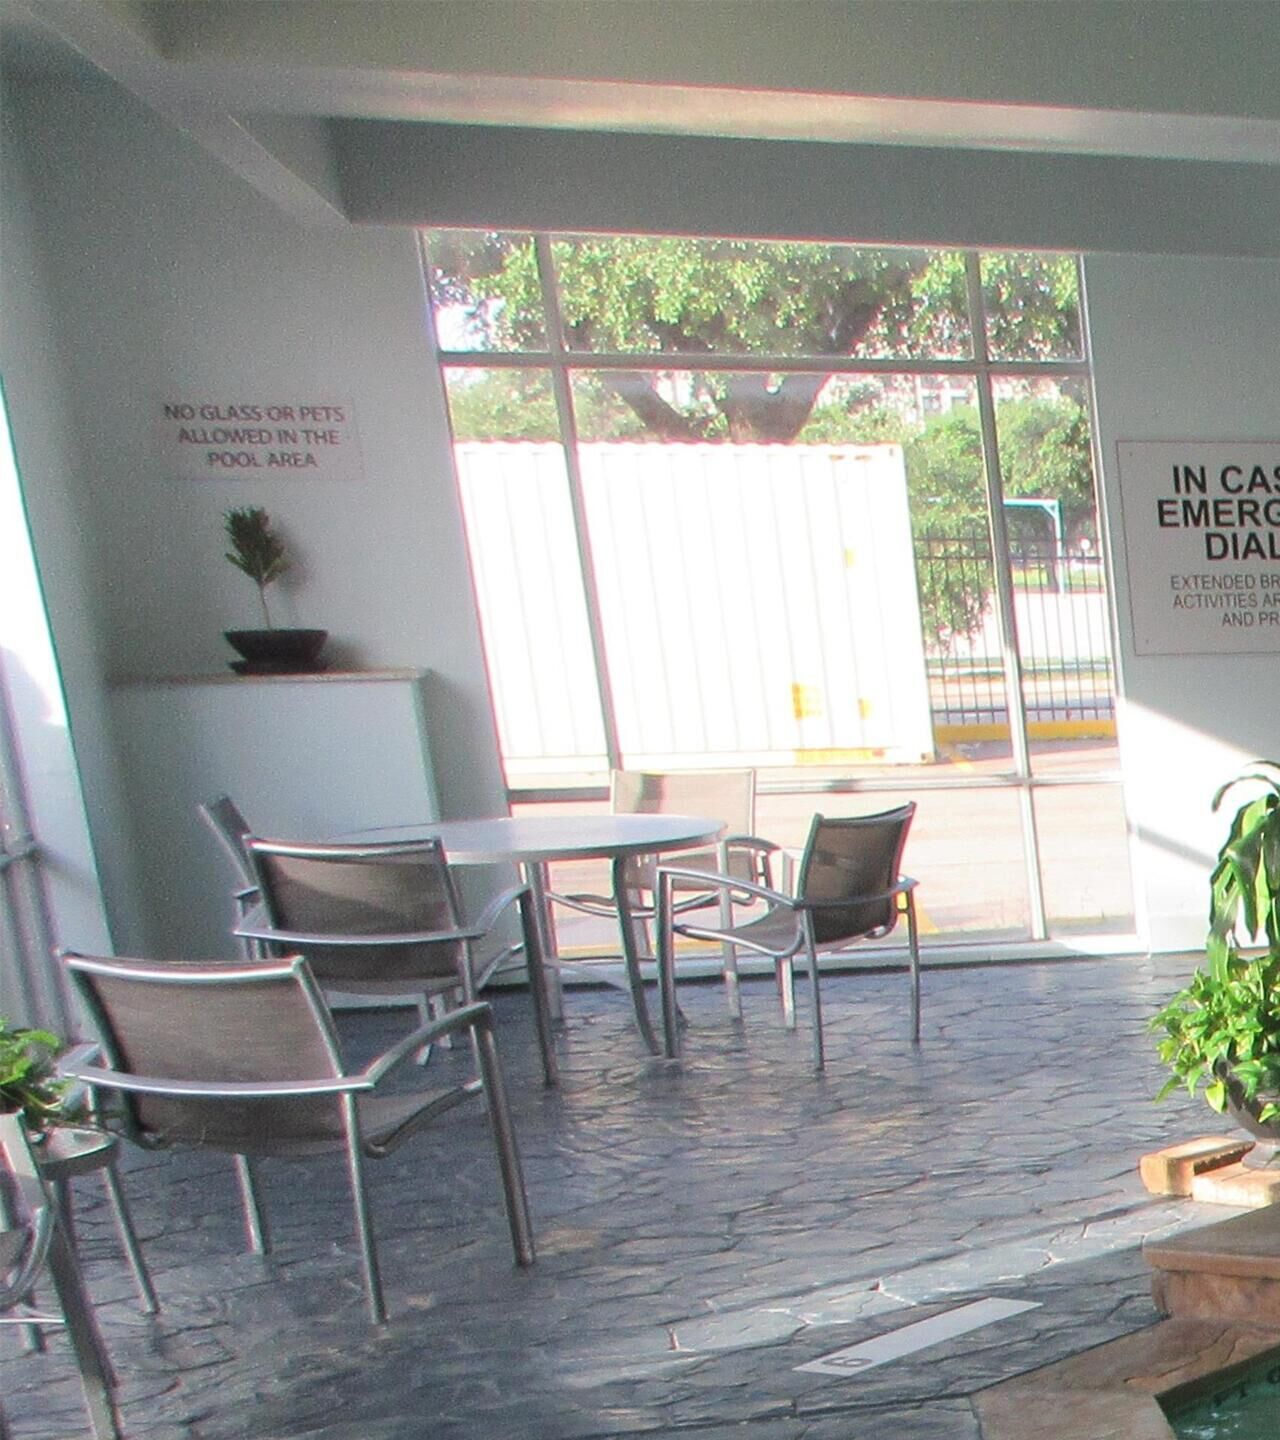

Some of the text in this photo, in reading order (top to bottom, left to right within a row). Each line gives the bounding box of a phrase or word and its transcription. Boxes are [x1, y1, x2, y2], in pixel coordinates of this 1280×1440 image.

[164, 404, 345, 422] NO GLASS OR PETS
[178, 428, 340, 445] ALLOWED IN THE
[207, 451, 318, 468] POOL AREA
[1172, 465, 1207, 495] IN
[1170, 575, 1256, 591] EXTENDED
[1173, 593, 1258, 610] ACTIVITIES
[1221, 612, 1253, 627] AND
